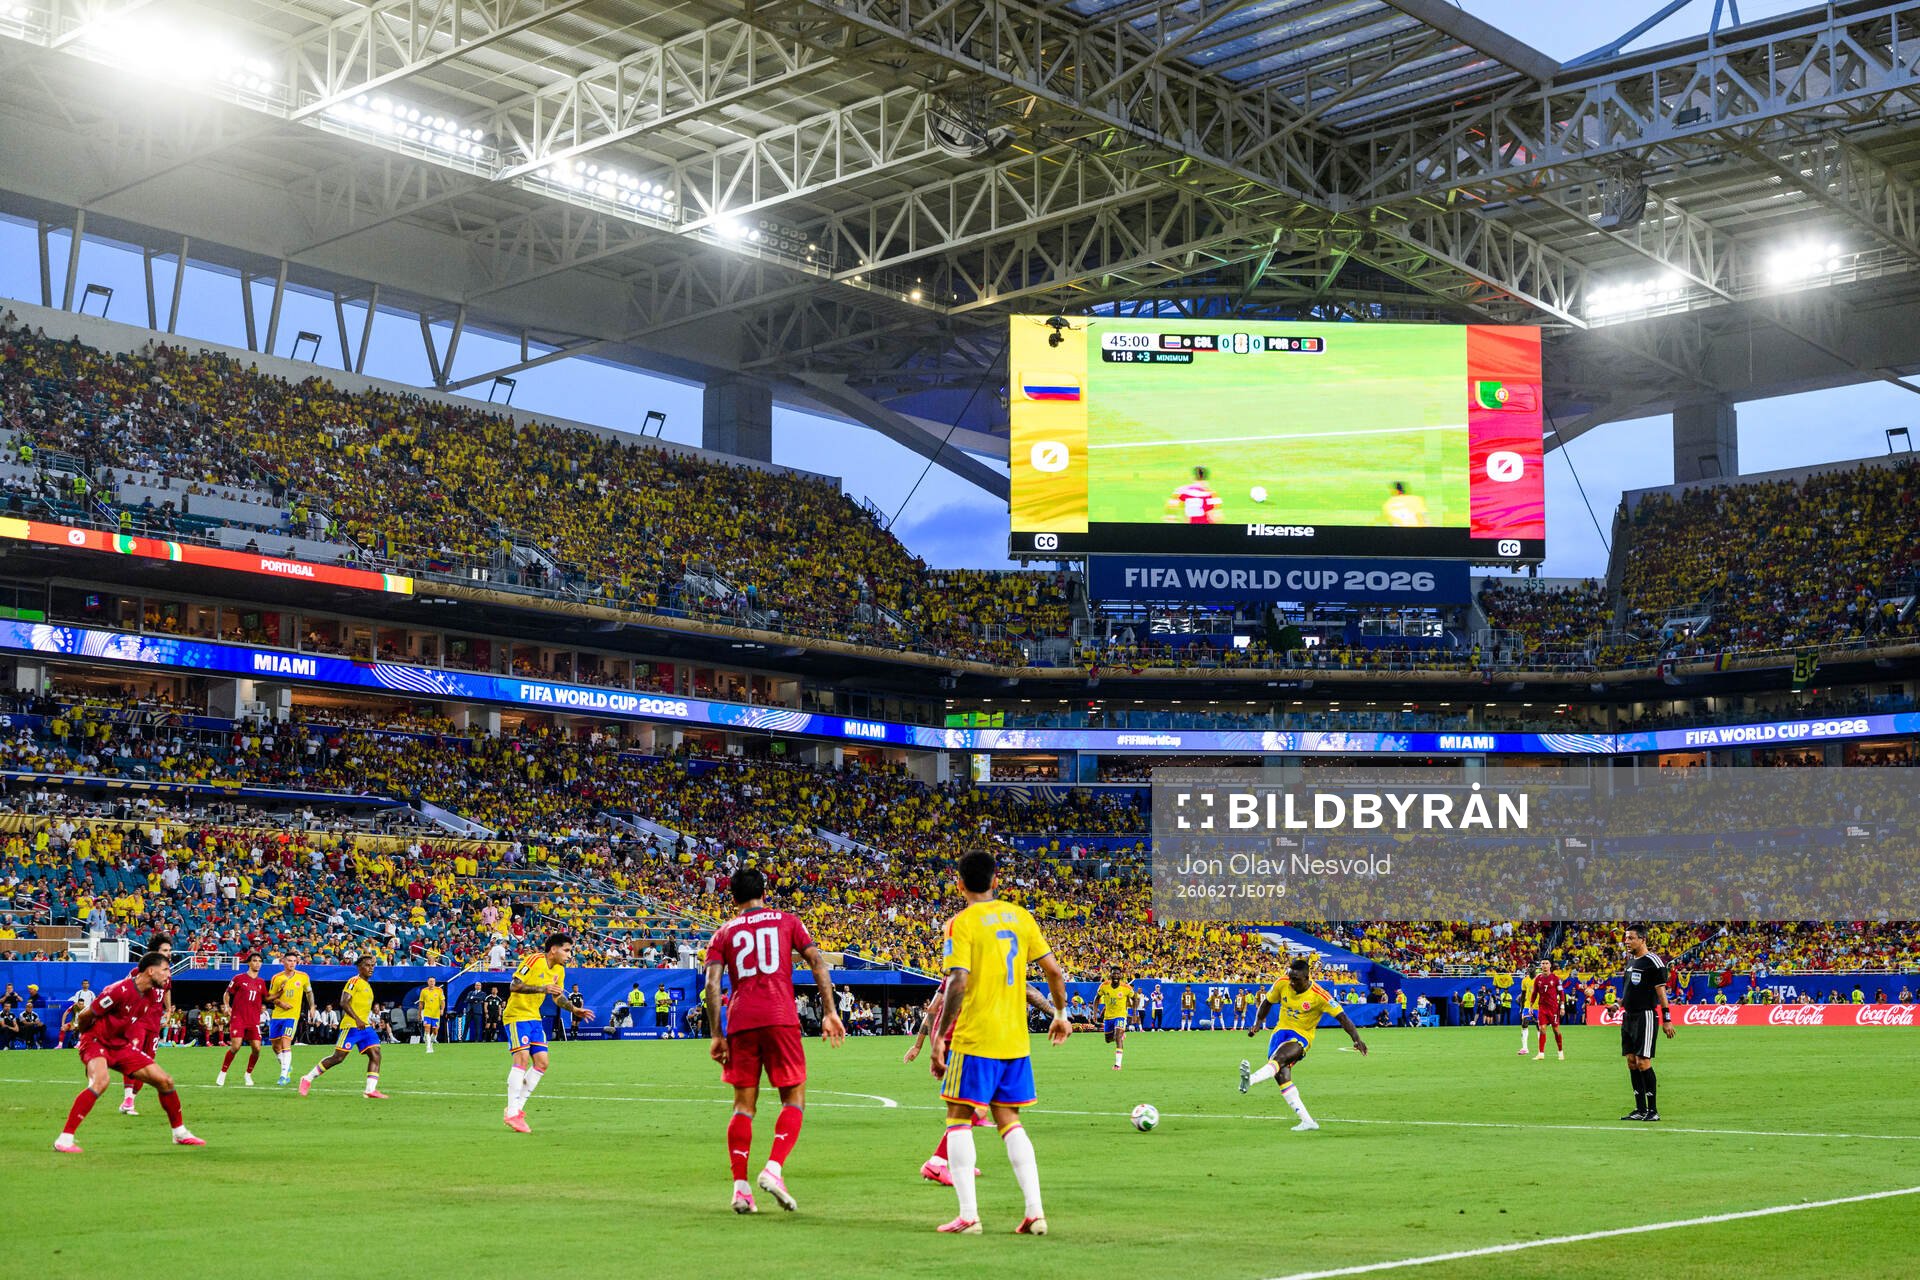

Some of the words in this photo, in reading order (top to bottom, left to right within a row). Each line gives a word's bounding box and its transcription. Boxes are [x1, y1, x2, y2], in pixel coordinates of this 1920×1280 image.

[1110, 336, 1149, 347] 45:00
[1222, 338, 1230, 348] 0
[1253, 339, 1261, 349] 0
[1111, 351, 1133, 361] 1:18
[1137, 352, 1150, 361] +3
[1156, 354, 1189, 362] MINIMUM
[1247, 523, 1315, 537] Hisense
[1037, 536, 1056, 548] CC
[1500, 543, 1519, 554] CC
[261, 559, 315, 577] PORTUGAL
[1125, 568, 1181, 588] FIFA
[1185, 568, 1281, 590] WORLD
[1286, 570, 1339, 591] CUP
[1344, 571, 1436, 592] 2026
[254, 653, 316, 676] MIAMI
[520, 684, 552, 702] FIFA
[554, 687, 606, 708] WORLD
[609, 694, 638, 712] CUP
[639, 698, 688, 717] 2026
[844, 721, 886, 738] MIAMI
[1685, 730, 1718, 745] FIFA
[1719, 726, 1776, 743] WORLD
[1777, 723, 1810, 739] CUP
[1811, 719, 1869, 736] 2026
[1440, 736, 1494, 749] MIAMI
[732, 926, 780, 980] 20
[996, 929, 1019, 986] 7
[249, 990, 257, 1001] 11
[1544, 984, 1549, 993] 7
[1684, 1005, 1740, 1025] Coca-Cola
[1769, 1005, 1826, 1025] Coca-Cola
[1856, 1004, 1916, 1025] Coca-Cola
[284, 1027, 293, 1036] 10
